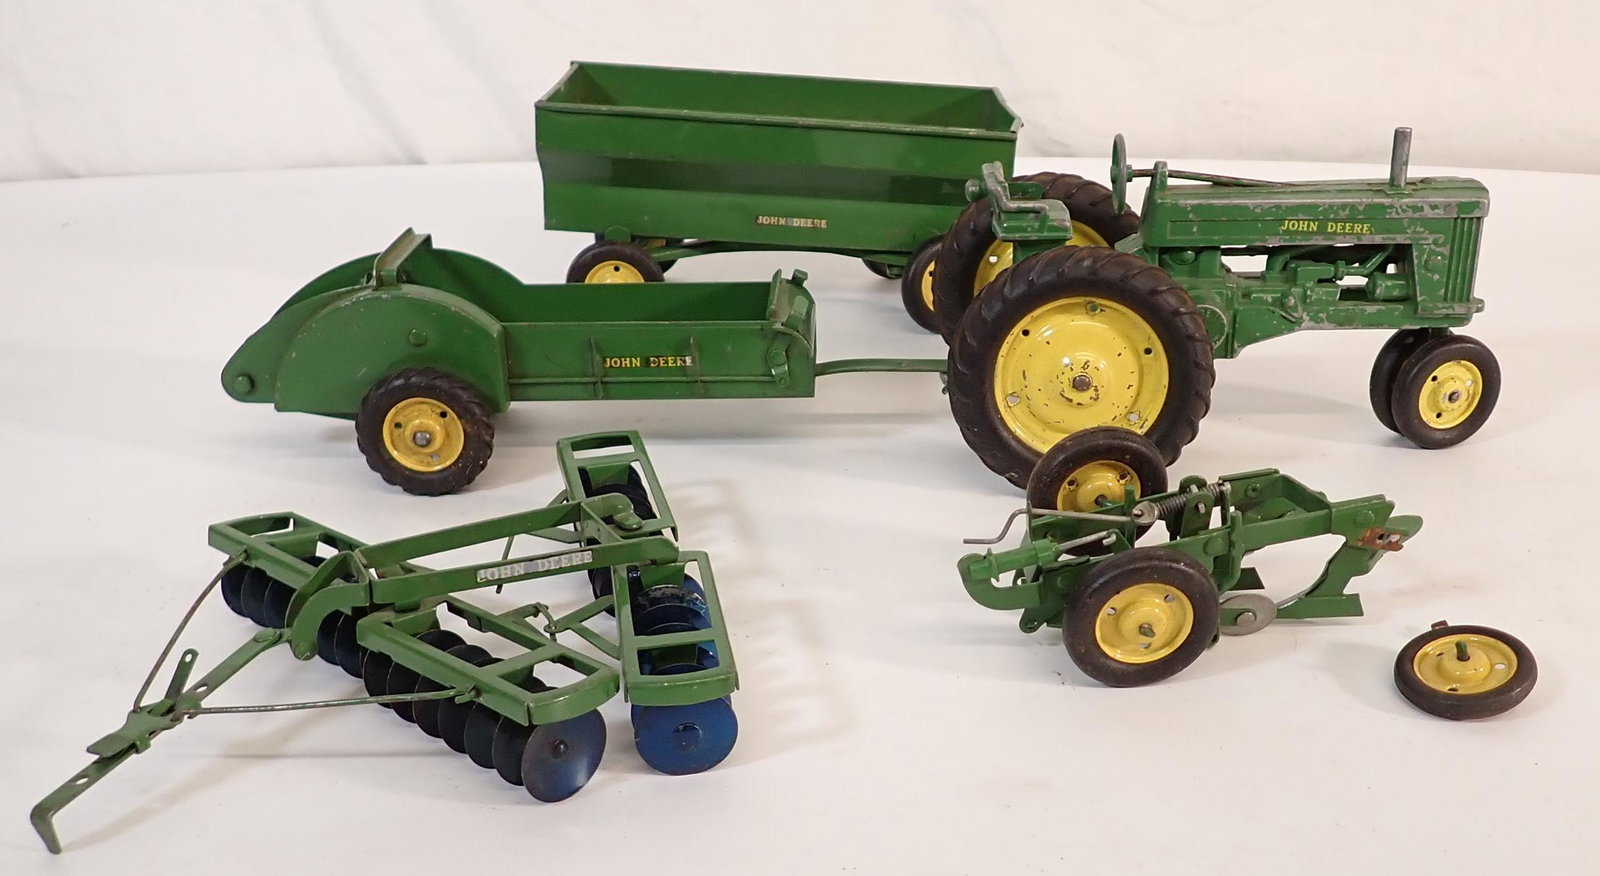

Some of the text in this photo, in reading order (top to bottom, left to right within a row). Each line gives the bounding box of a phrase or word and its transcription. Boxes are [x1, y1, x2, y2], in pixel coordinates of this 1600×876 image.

[756, 215, 828, 228] JOHN DEERE
[1281, 220, 1371, 234] JOHN DEERE
[603, 355, 693, 368] JOHN DEERE
